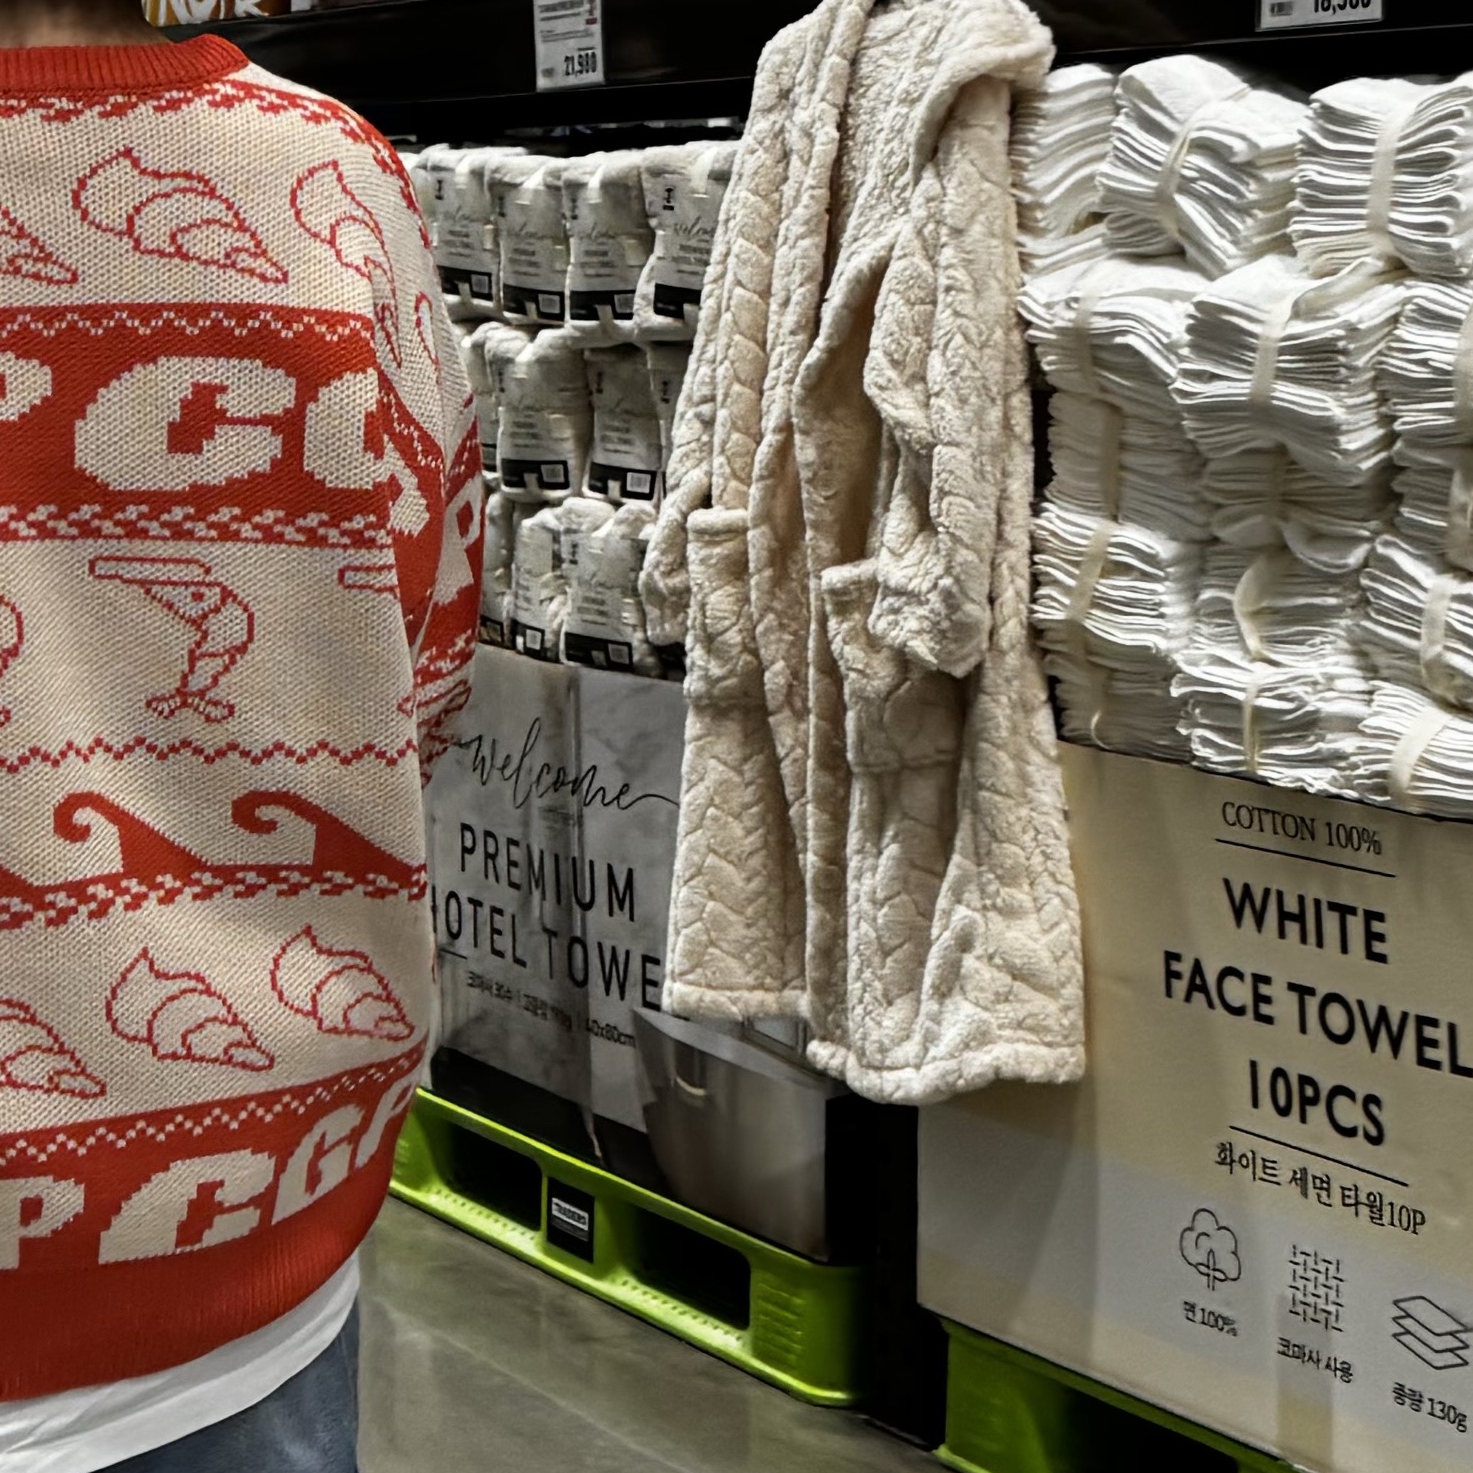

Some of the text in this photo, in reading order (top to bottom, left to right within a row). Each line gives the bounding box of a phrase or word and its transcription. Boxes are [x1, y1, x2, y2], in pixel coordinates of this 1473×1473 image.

[450, 716, 680, 810] welcome
[1221, 800, 1383, 855] COTTON 100%
[459, 822, 635, 922] PREMIUM
[1222, 877, 1389, 964] WHITE
[542, 926, 690, 1021] TOWE
[1163, 949, 1473, 1079] FACE TOWEL
[1249, 1059, 1385, 1147] 10PCS
[1214, 1141, 1282, 1186] 화이트
[1289, 1166, 1333, 1208] 세면
[1426, 1397, 1468, 1434] 130g
